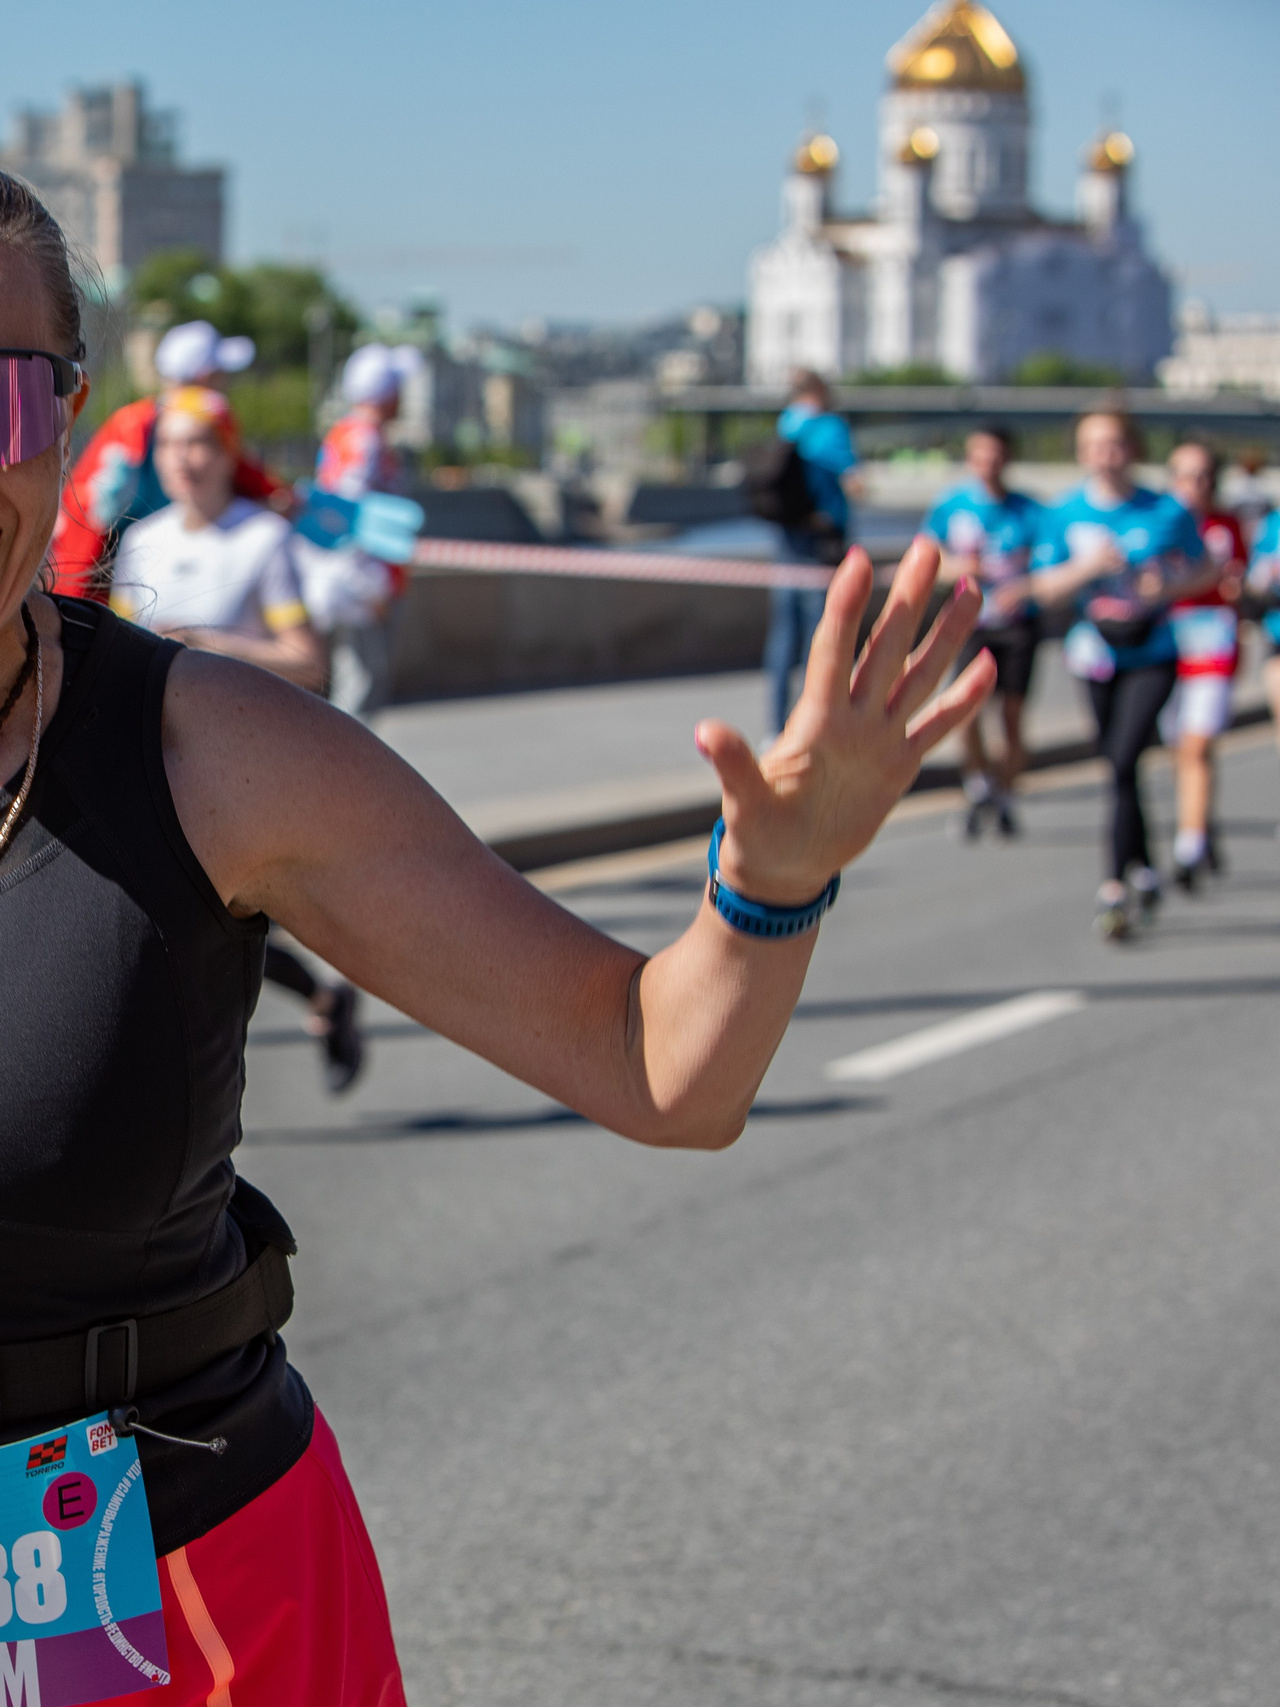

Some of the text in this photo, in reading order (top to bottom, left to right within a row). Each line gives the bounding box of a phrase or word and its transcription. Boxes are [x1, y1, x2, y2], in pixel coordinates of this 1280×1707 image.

[90, 1424, 112, 1440] FON
[92, 1433, 114, 1452] BET
[25, 1461, 65, 1479] TORERO
[58, 1481, 84, 1520] E
[93, 1476, 132, 1571] #САМОВЫРАЖЕНИЕ
[93, 1572, 113, 1626] #ГОРДОСТЬ
[104, 1622, 144, 1668] #ЕДИНСТВО
